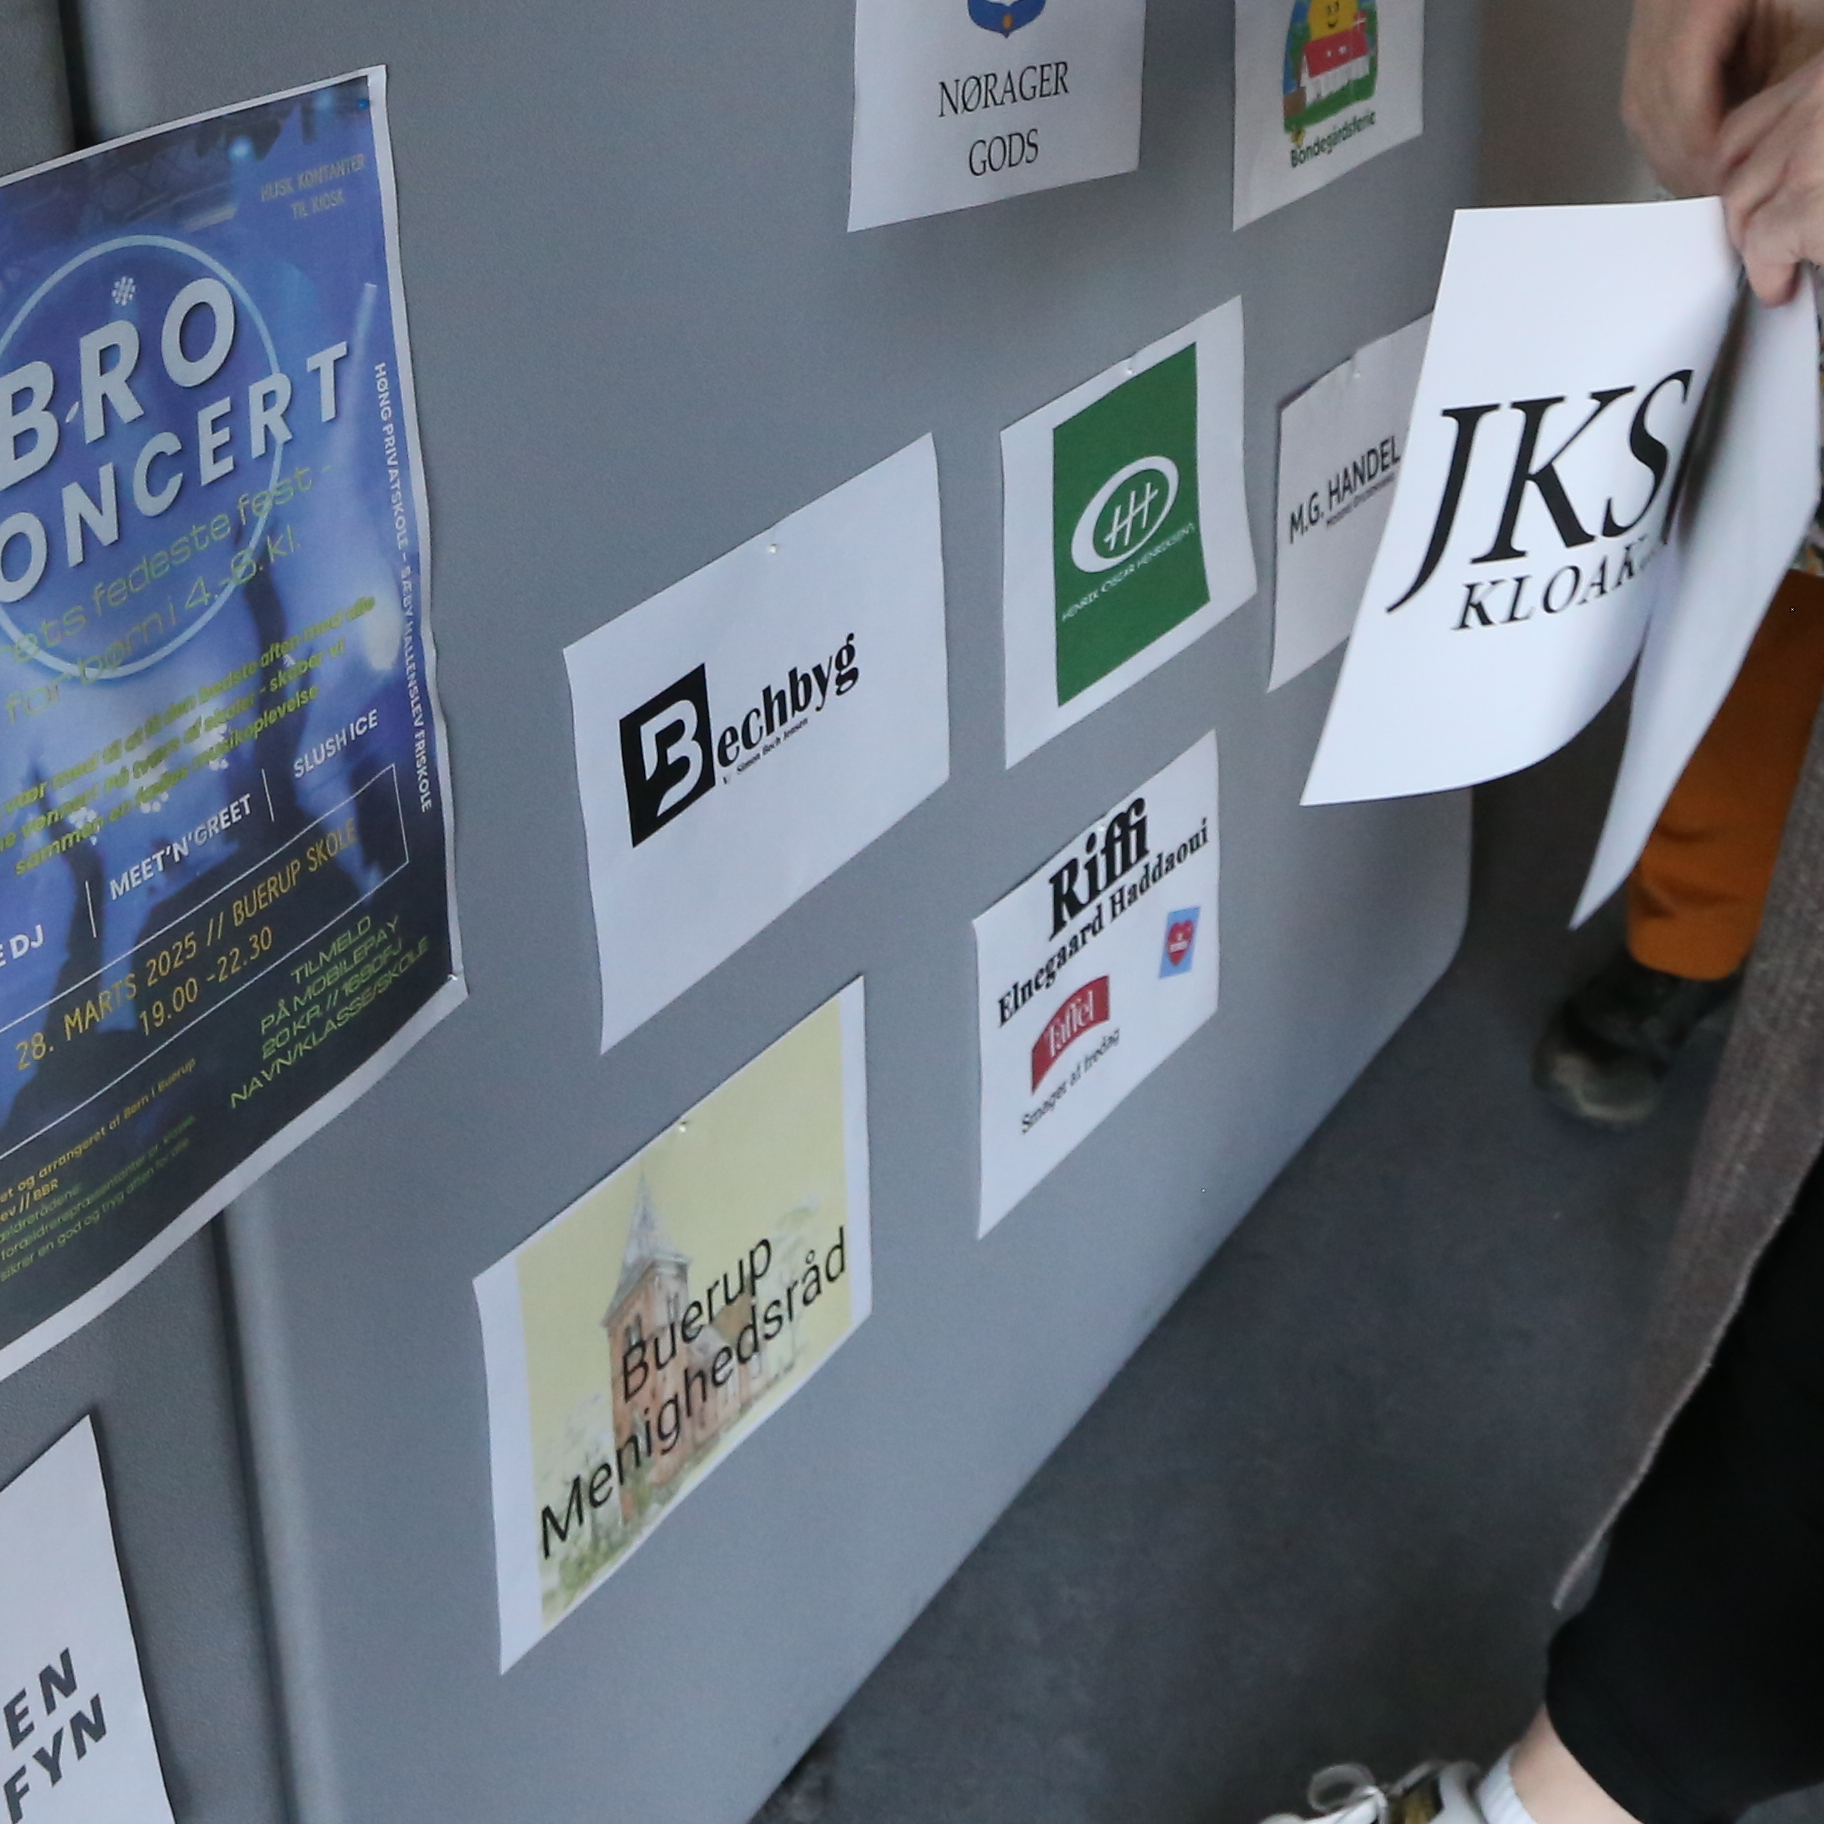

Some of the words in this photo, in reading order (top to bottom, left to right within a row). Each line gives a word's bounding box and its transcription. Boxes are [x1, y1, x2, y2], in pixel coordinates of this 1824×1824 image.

[937, 60, 1071, 119] NØRAGER
[967, 127, 1040, 177] GODS
[373, 361, 394, 422] HØNG
[381, 422, 410, 551] PRIVATSKOLE
[1289, 490, 1325, 545] M.G.
[1327, 434, 1402, 512] HANDEL
[1386, 369, 1694, 615] JKS
[91, 512, 232, 616] fedeste
[235, 465, 314, 526] fest
[4, 671, 73, 725] for
[77, 610, 164, 686] børn
[264, 523, 302, 565] kl.
[291, 733, 349, 780] SLUSH
[348, 707, 379, 741] ICE
[413, 728, 434, 814] FRISKOLE
[14, 816, 106, 876] sammen
[1047, 796, 1151, 944] Riffi
[9, 923, 47, 961] DJ
[15, 1030, 55, 1072] 28.
[62, 972, 139, 1042] MARTS
[144, 930, 199, 987] 2025
[230, 858, 302, 928] BUERUP
[305, 816, 358, 873] SKOLE
[290, 914, 372, 985] TILMELD
[997, 900, 1106, 1030] Elnegaard
[1109, 816, 1211, 926] Haddaoui
[138, 976, 199, 1038] 19.00
[259, 998, 292, 1036] PÅ
[292, 914, 400, 1012] MOBILEPAY
[261, 1026, 291, 1061] 20
[16, 1174, 37, 1193] og
[38, 1126, 107, 1179] arrangeret
[620, 1236, 774, 1405] Buerup
[541, 1224, 848, 1562] Menighedsråd
